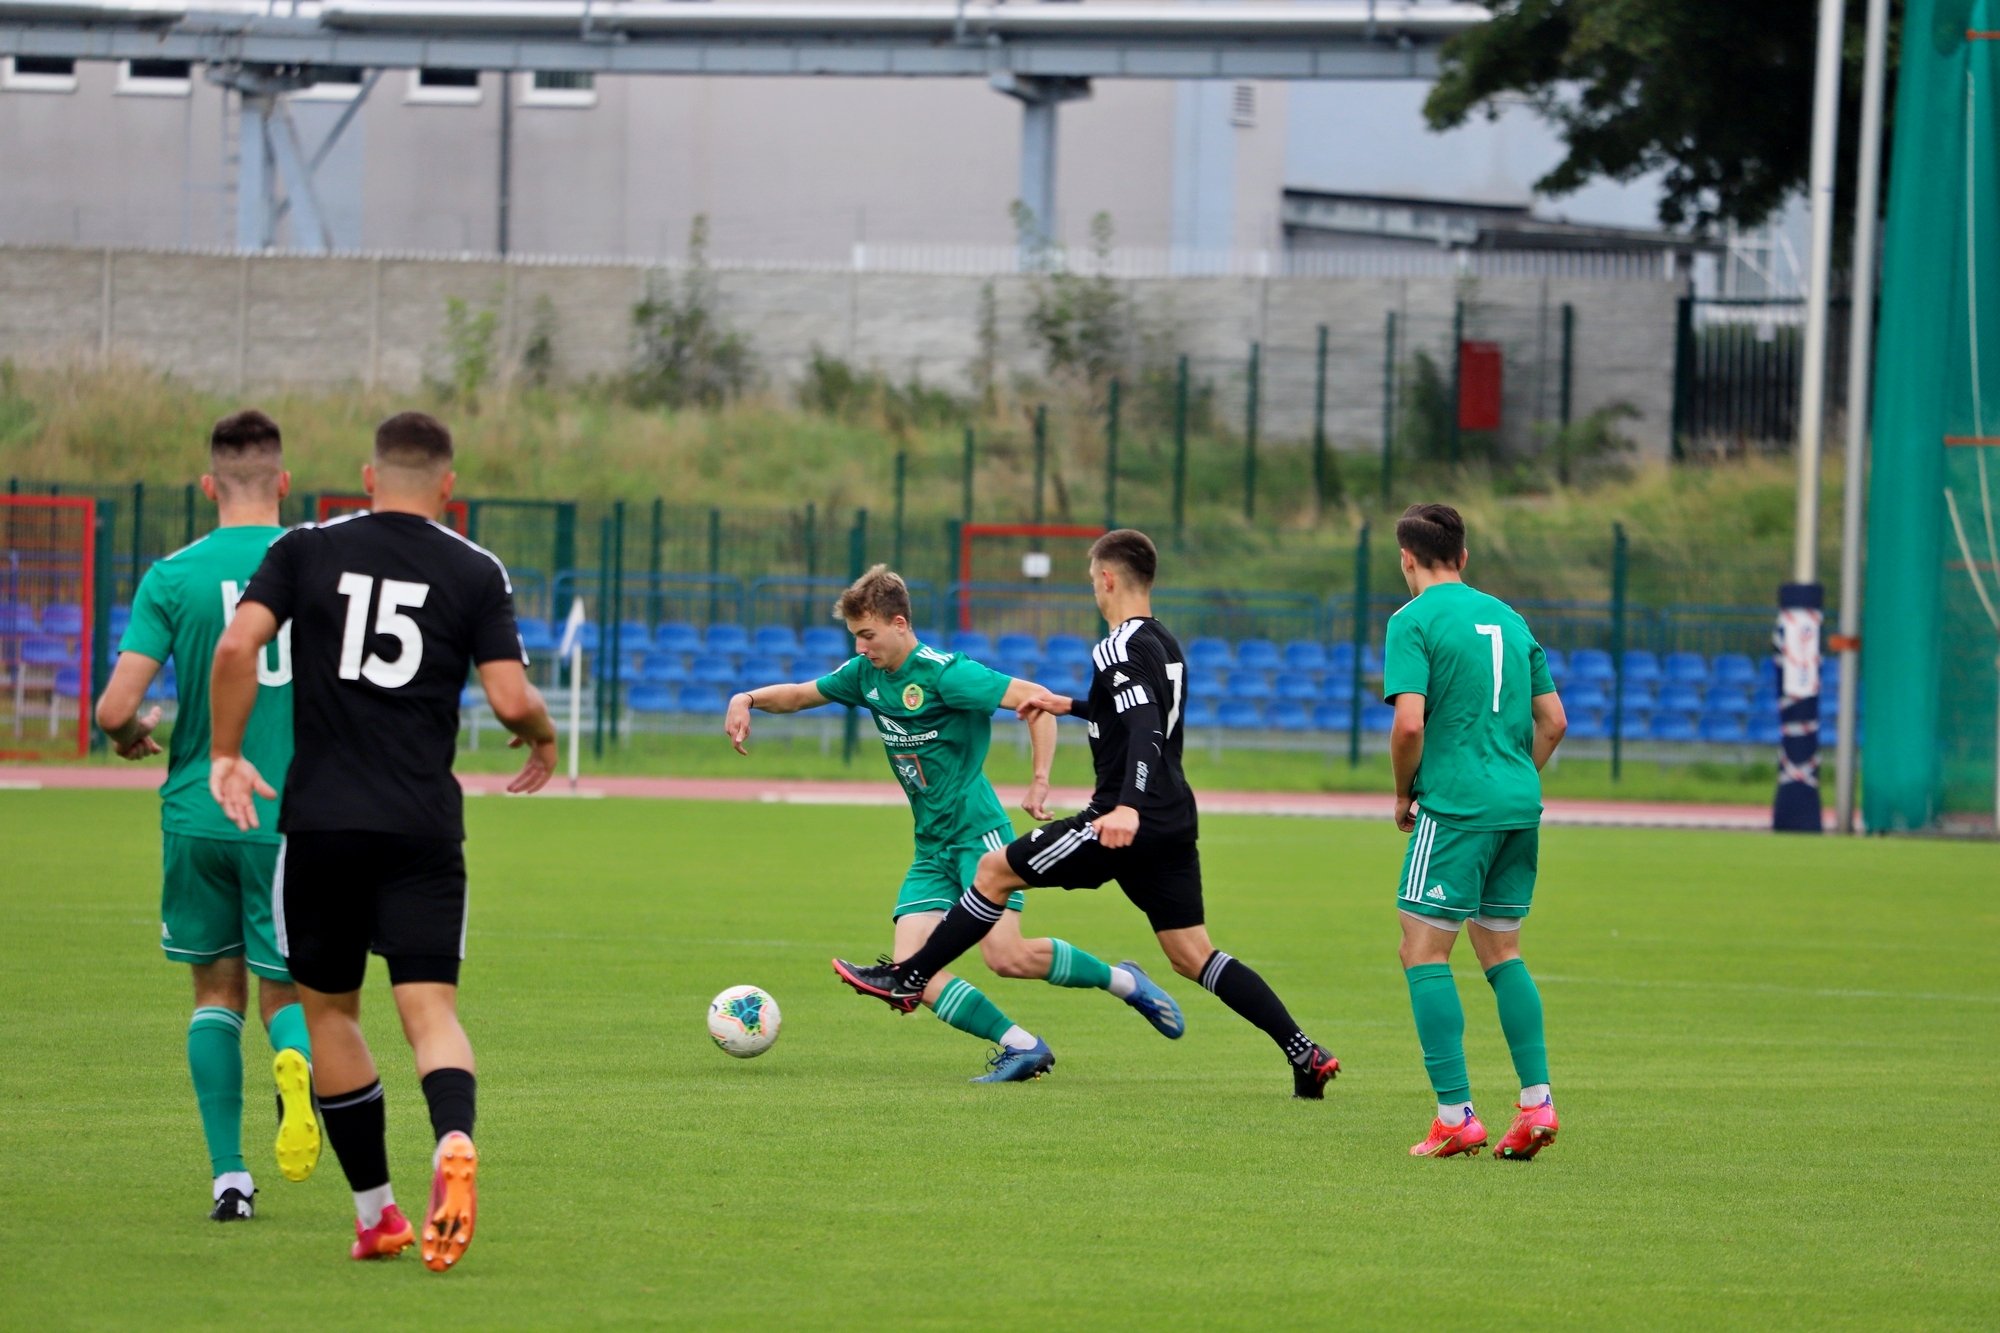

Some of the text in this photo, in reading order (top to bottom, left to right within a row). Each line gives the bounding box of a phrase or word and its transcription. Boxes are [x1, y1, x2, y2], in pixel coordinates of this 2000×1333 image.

[338, 571, 430, 688] 15
[1475, 624, 1503, 713] 7
[1165, 662, 1184, 739] 7
